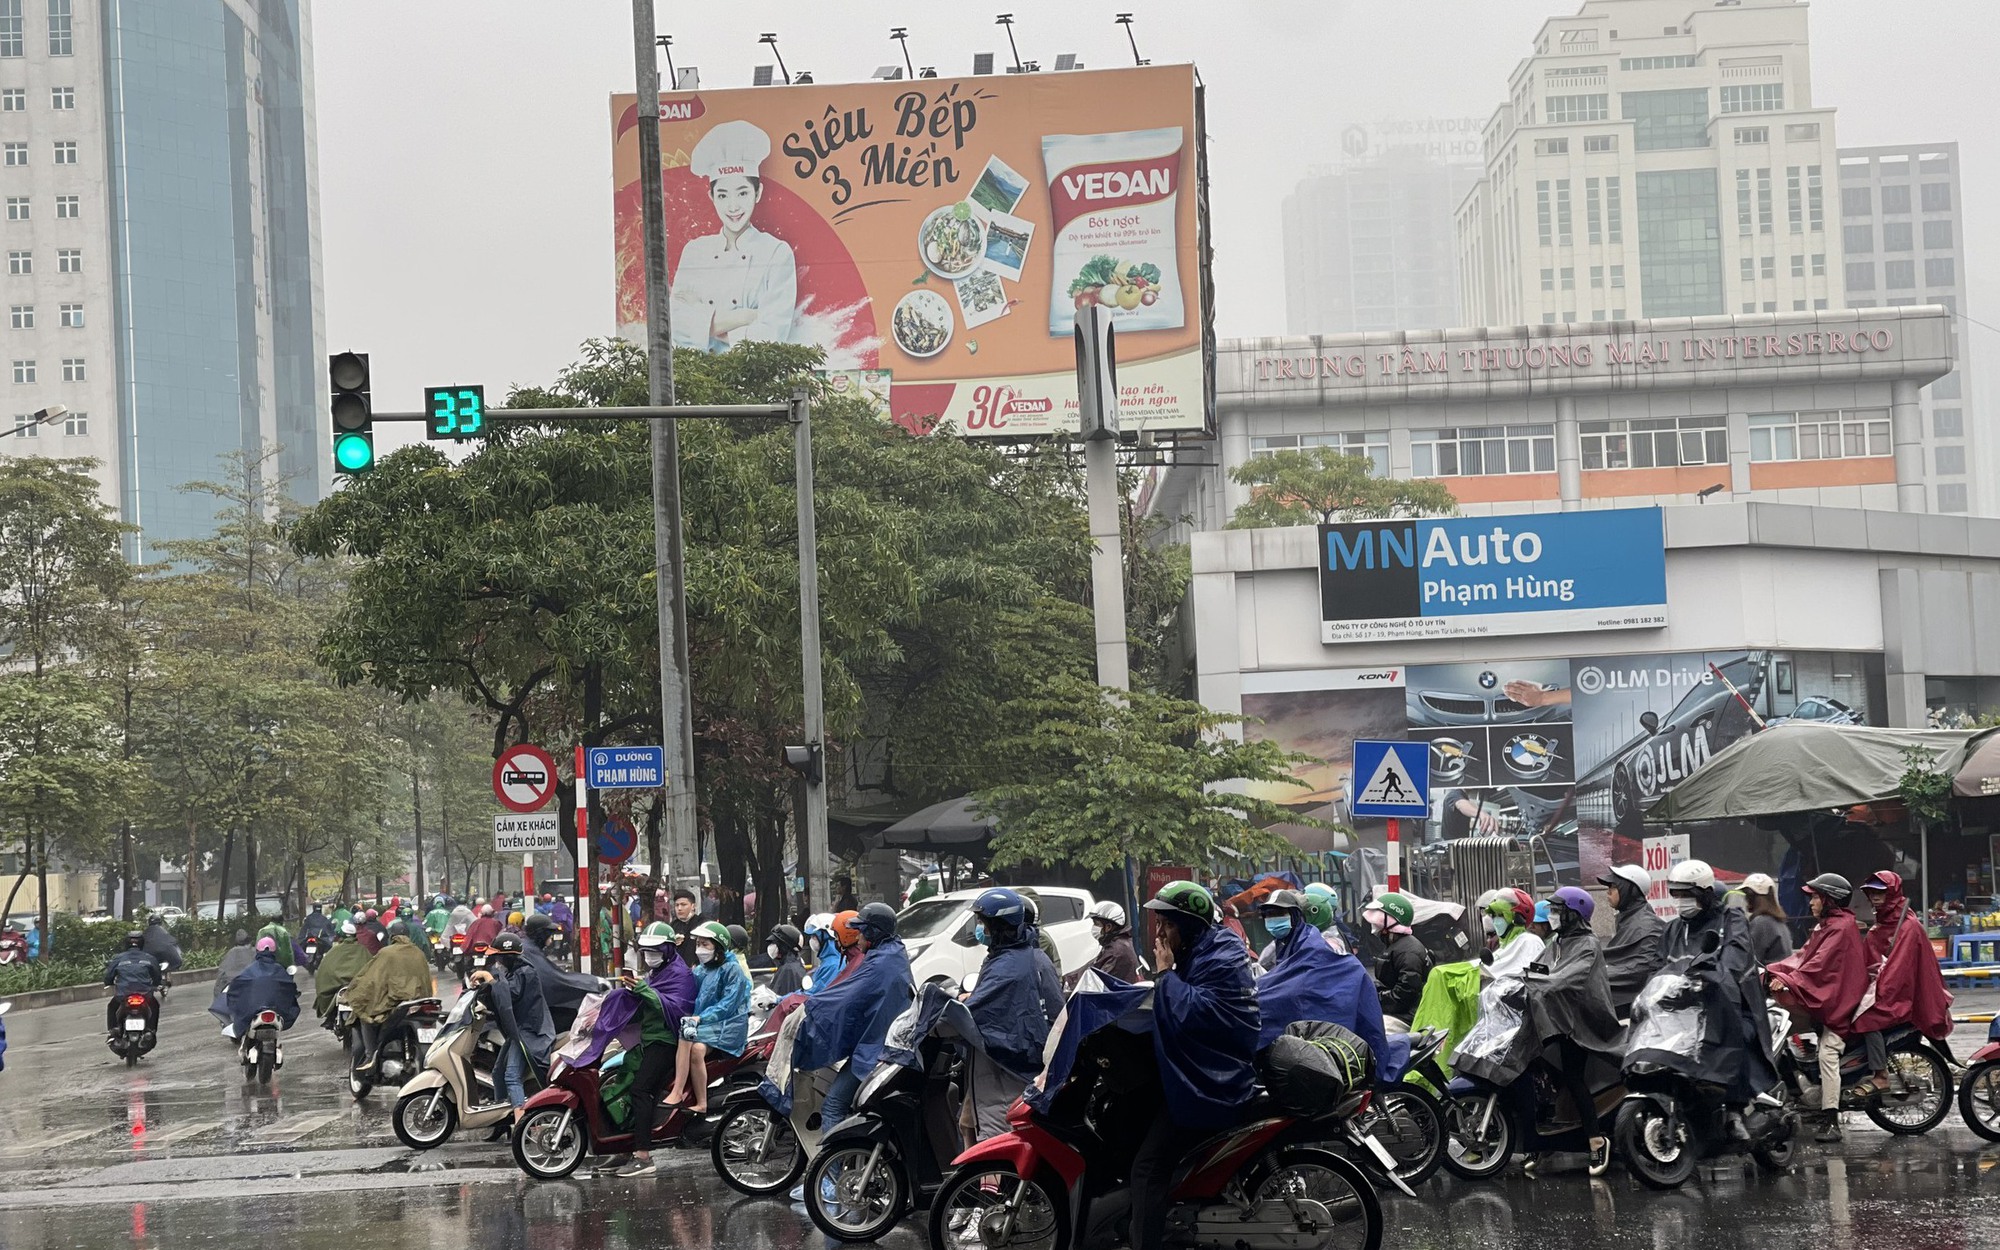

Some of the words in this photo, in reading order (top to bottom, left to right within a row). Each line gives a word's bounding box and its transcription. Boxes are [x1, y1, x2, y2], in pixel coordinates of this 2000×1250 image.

[782, 104, 873, 178] Siêu
[894, 83, 977, 150] Bếp
[718, 166, 744, 175] VEDAN
[822, 165, 852, 205] 3
[860, 142, 960, 188] Miền
[1061, 168, 1170, 200] VEDAN
[1088, 217, 1109, 230] Bột
[1113, 215, 1140, 229] ngọt
[1255, 354, 1366, 380] TRUNG
[1376, 346, 1447, 375] TÂM
[1458, 344, 1594, 371] THƯƠNG
[1606, 338, 1670, 368] MẠI
[1683, 328, 1893, 361] INTERSERCO
[1120, 385, 1140, 396] tạo
[1143, 383, 1164, 394] nên
[1010, 401, 1046, 411] VEDAN
[1120, 396, 1144, 407] món
[1149, 395, 1177, 408] ngon
[434, 390, 481, 433] 33
[1327, 527, 1414, 570] MN
[1422, 526, 1542, 568] Auto
[1424, 579, 1497, 606] Phạm
[1507, 575, 1575, 601] Hùng
[1369, 621, 1388, 629] CÔNG
[1389, 620, 1407, 628] NGHỆ
[1623, 617, 1639, 625] 0981
[1357, 672, 1395, 681] KONI
[1606, 669, 1649, 688] JLM
[1656, 668, 1714, 686] Drive
[616, 751, 653, 762] ĐƯỜNG
[1657, 725, 1711, 784] JLM
[597, 768, 627, 785] PHẠM
[630, 765, 657, 782] HÙNG
[496, 819, 515, 832] CẤM
[517, 821, 527, 831] XE
[529, 818, 556, 831] KHÁCH
[498, 835, 523, 848] TUYẾN
[525, 835, 536, 847] CỐ
[537, 836, 556, 848] ĐỊNH
[1646, 843, 1667, 871] XÔI
[1389, 903, 1405, 915] Grab
